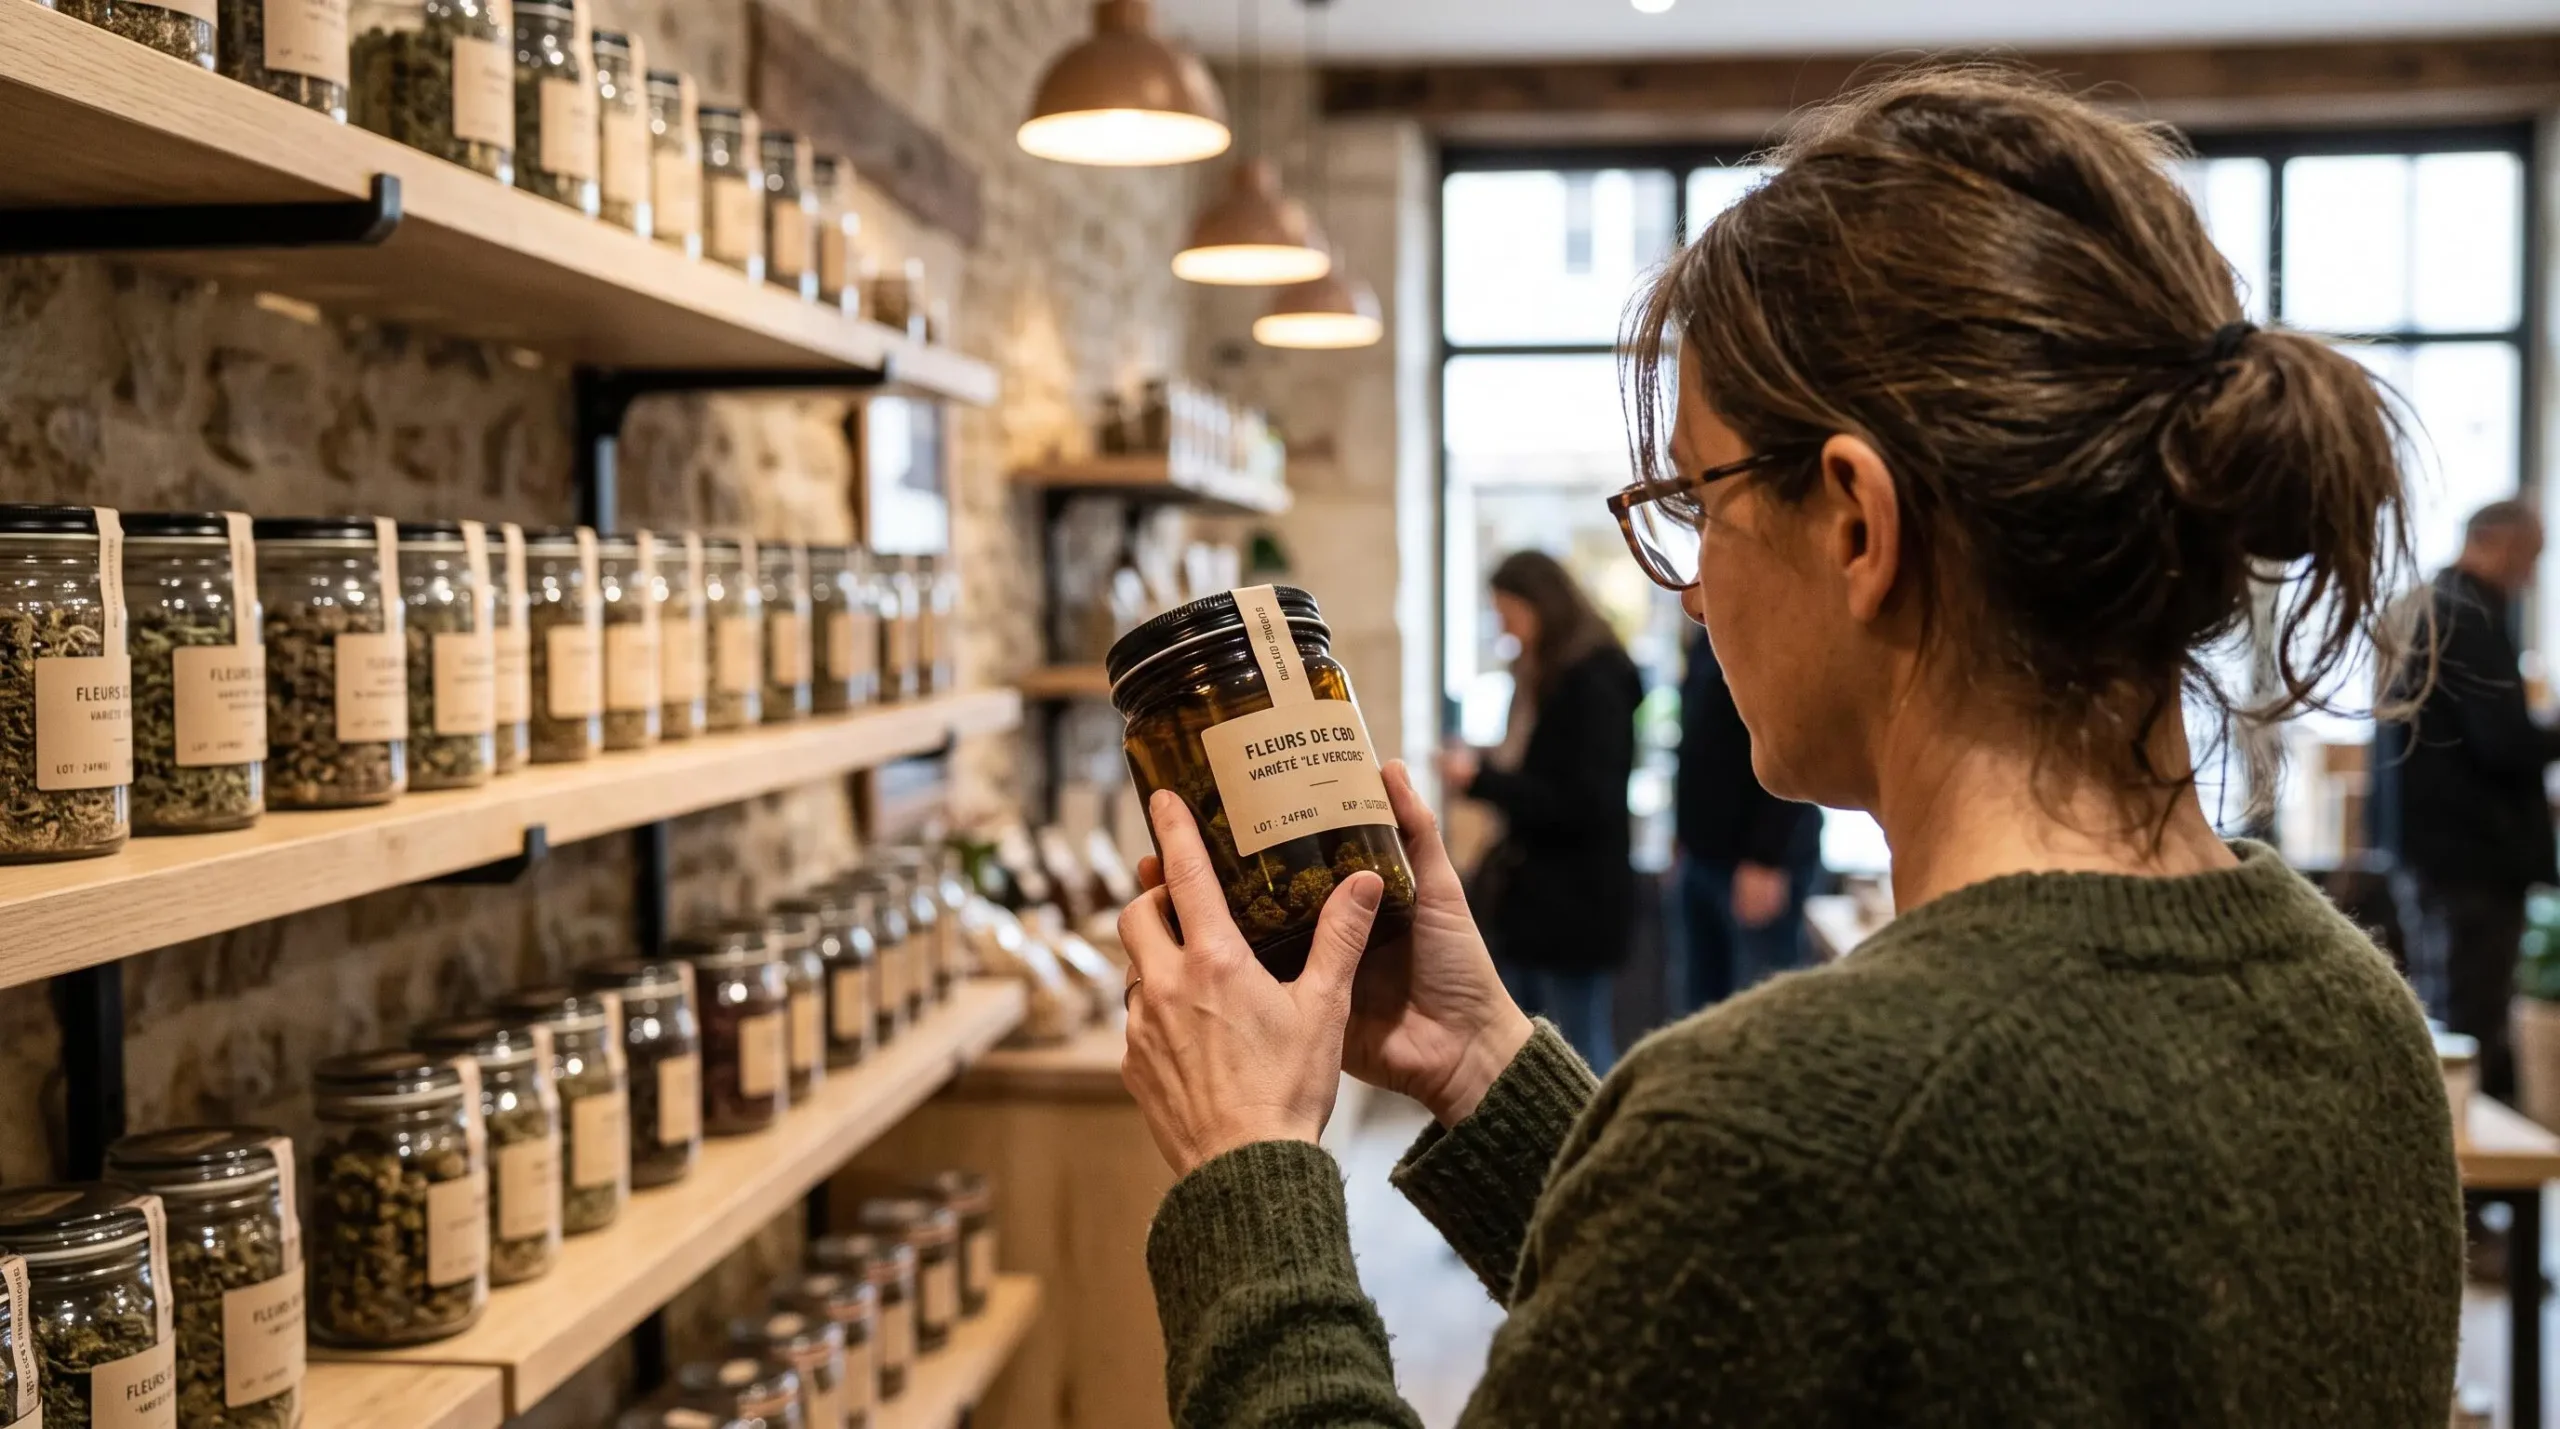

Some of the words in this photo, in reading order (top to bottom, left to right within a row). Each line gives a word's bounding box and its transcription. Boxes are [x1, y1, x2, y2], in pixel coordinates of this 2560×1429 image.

[76, 686, 120, 702] FLEURS
[1245, 731, 1307, 760] FLEURS
[1310, 728, 1330, 744] DE
[1332, 727, 1355, 741] CBD
[1249, 756, 1298, 781] VARIÉTÉ
[1301, 754, 1320, 767] "LE
[1281, 807, 1319, 825] 24FR01
